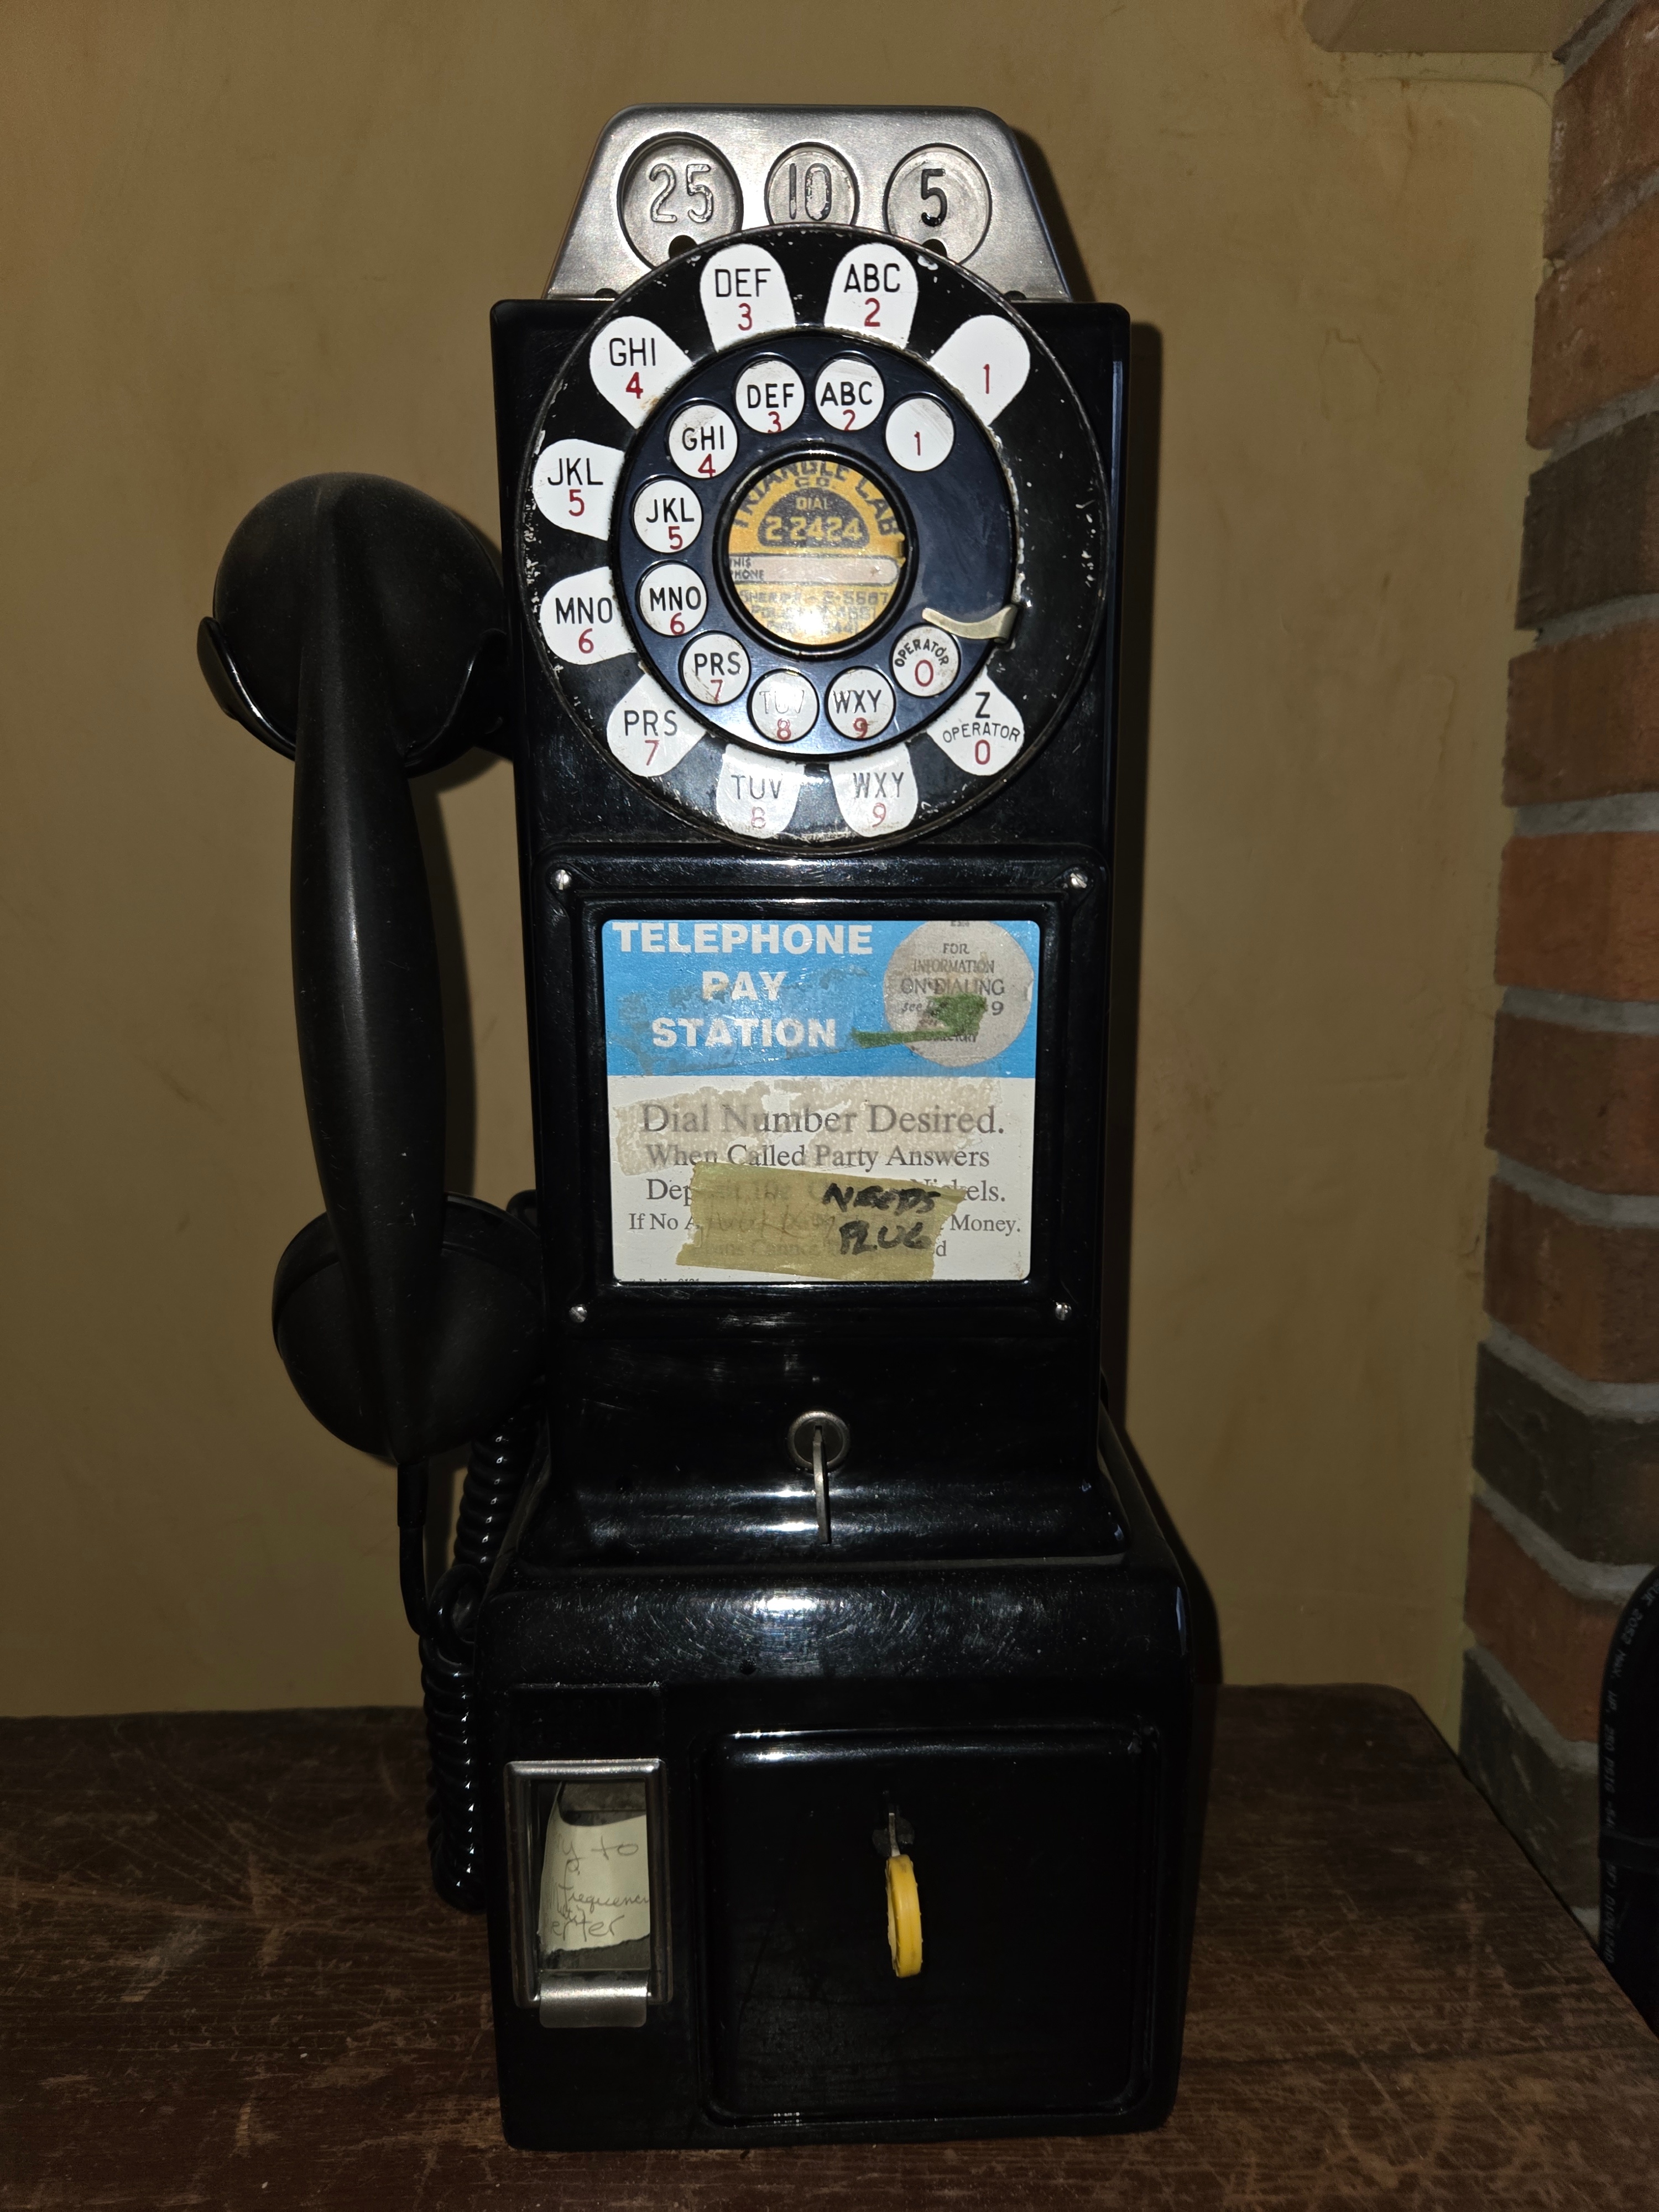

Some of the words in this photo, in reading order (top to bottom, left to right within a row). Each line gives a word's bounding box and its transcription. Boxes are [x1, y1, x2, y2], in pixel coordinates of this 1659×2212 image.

[649, 163, 714, 223] 25
[789, 163, 832, 221] 10
[921, 168, 947, 227] 5
[714, 268, 771, 298] DEF
[843, 263, 901, 293] ABC
[738, 303, 752, 331] 3
[864, 298, 880, 327] 2
[609, 337, 656, 367] GHI
[625, 372, 643, 399] 4
[983, 364, 990, 394] 1
[747, 383, 795, 409] DEF
[820, 381, 872, 406] ABC
[768, 411, 782, 434] 3
[842, 409, 857, 431] 2
[682, 425, 724, 451] GHI
[914, 431, 921, 456] 1
[547, 457, 603, 486] JKL
[697, 453, 716, 477] 4
[568, 489, 585, 517] 5
[646, 497, 695, 523] JKL
[795, 497, 830, 510] DIAL
[668, 526, 683, 550] 5
[555, 597, 613, 624] MNO
[649, 586, 701, 612] MNO
[670, 612, 685, 635] 6
[578, 628, 594, 654] 6
[894, 638, 950, 668] OPERATOR
[694, 651, 741, 676] PRS
[710, 679, 723, 702] 7
[759, 690, 805, 714] TUV
[833, 689, 881, 713] WXY
[975, 692, 990, 719] Z
[624, 710, 677, 736] PRS
[776, 718, 791, 740] 8
[853, 717, 868, 738] 9
[943, 722, 1021, 743] OPERATOR
[645, 740, 660, 766] 7
[733, 775, 782, 800] TUV
[853, 772, 904, 798] WXY
[752, 807, 766, 829] 8
[872, 802, 886, 828] 9
[612, 922, 873, 954] TELEPHONE
[943, 943, 969, 954] FOR
[914, 959, 995, 973] INFORMATION
[702, 971, 789, 1001] PAY
[901, 978, 927, 995] ON
[651, 1017, 836, 1048] STATION
[641, 1103, 708, 1133] Dial
[722, 1104, 857, 1133] Number
[868, 1104, 1004, 1134] Desired.
[645, 1144, 718, 1166] When
[727, 1144, 805, 1166] Called
[815, 1145, 879, 1172] Party
[885, 1145, 990, 1167] Answers
[629, 1213, 645, 1230] If
[650, 1213, 679, 1230] No
[950, 1214, 1021, 1237] Money.
[591, 1835, 639, 1860] to
